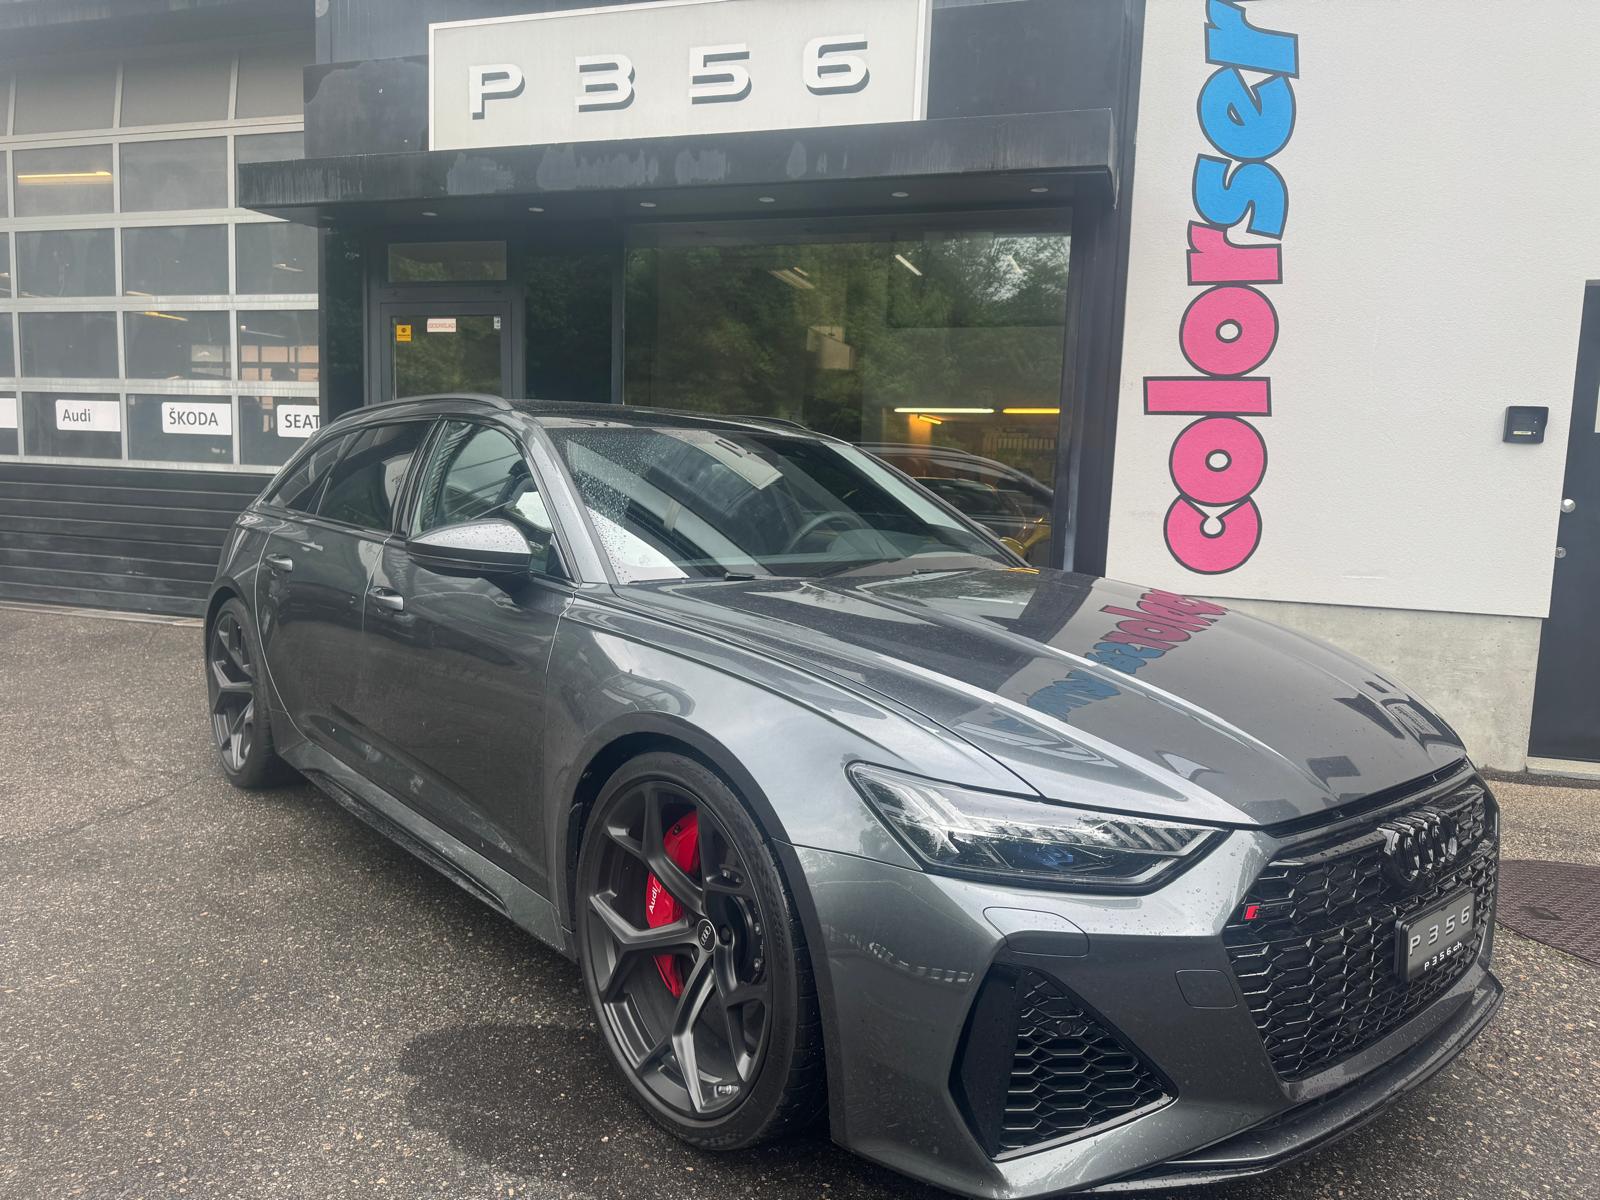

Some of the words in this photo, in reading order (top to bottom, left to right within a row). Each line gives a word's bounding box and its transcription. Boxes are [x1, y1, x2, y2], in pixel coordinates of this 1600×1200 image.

[63, 408, 91, 423] Audi
[169, 407, 218, 426] ŠKODA
[284, 413, 320, 429] SEAT
[648, 885, 658, 915] Audi
